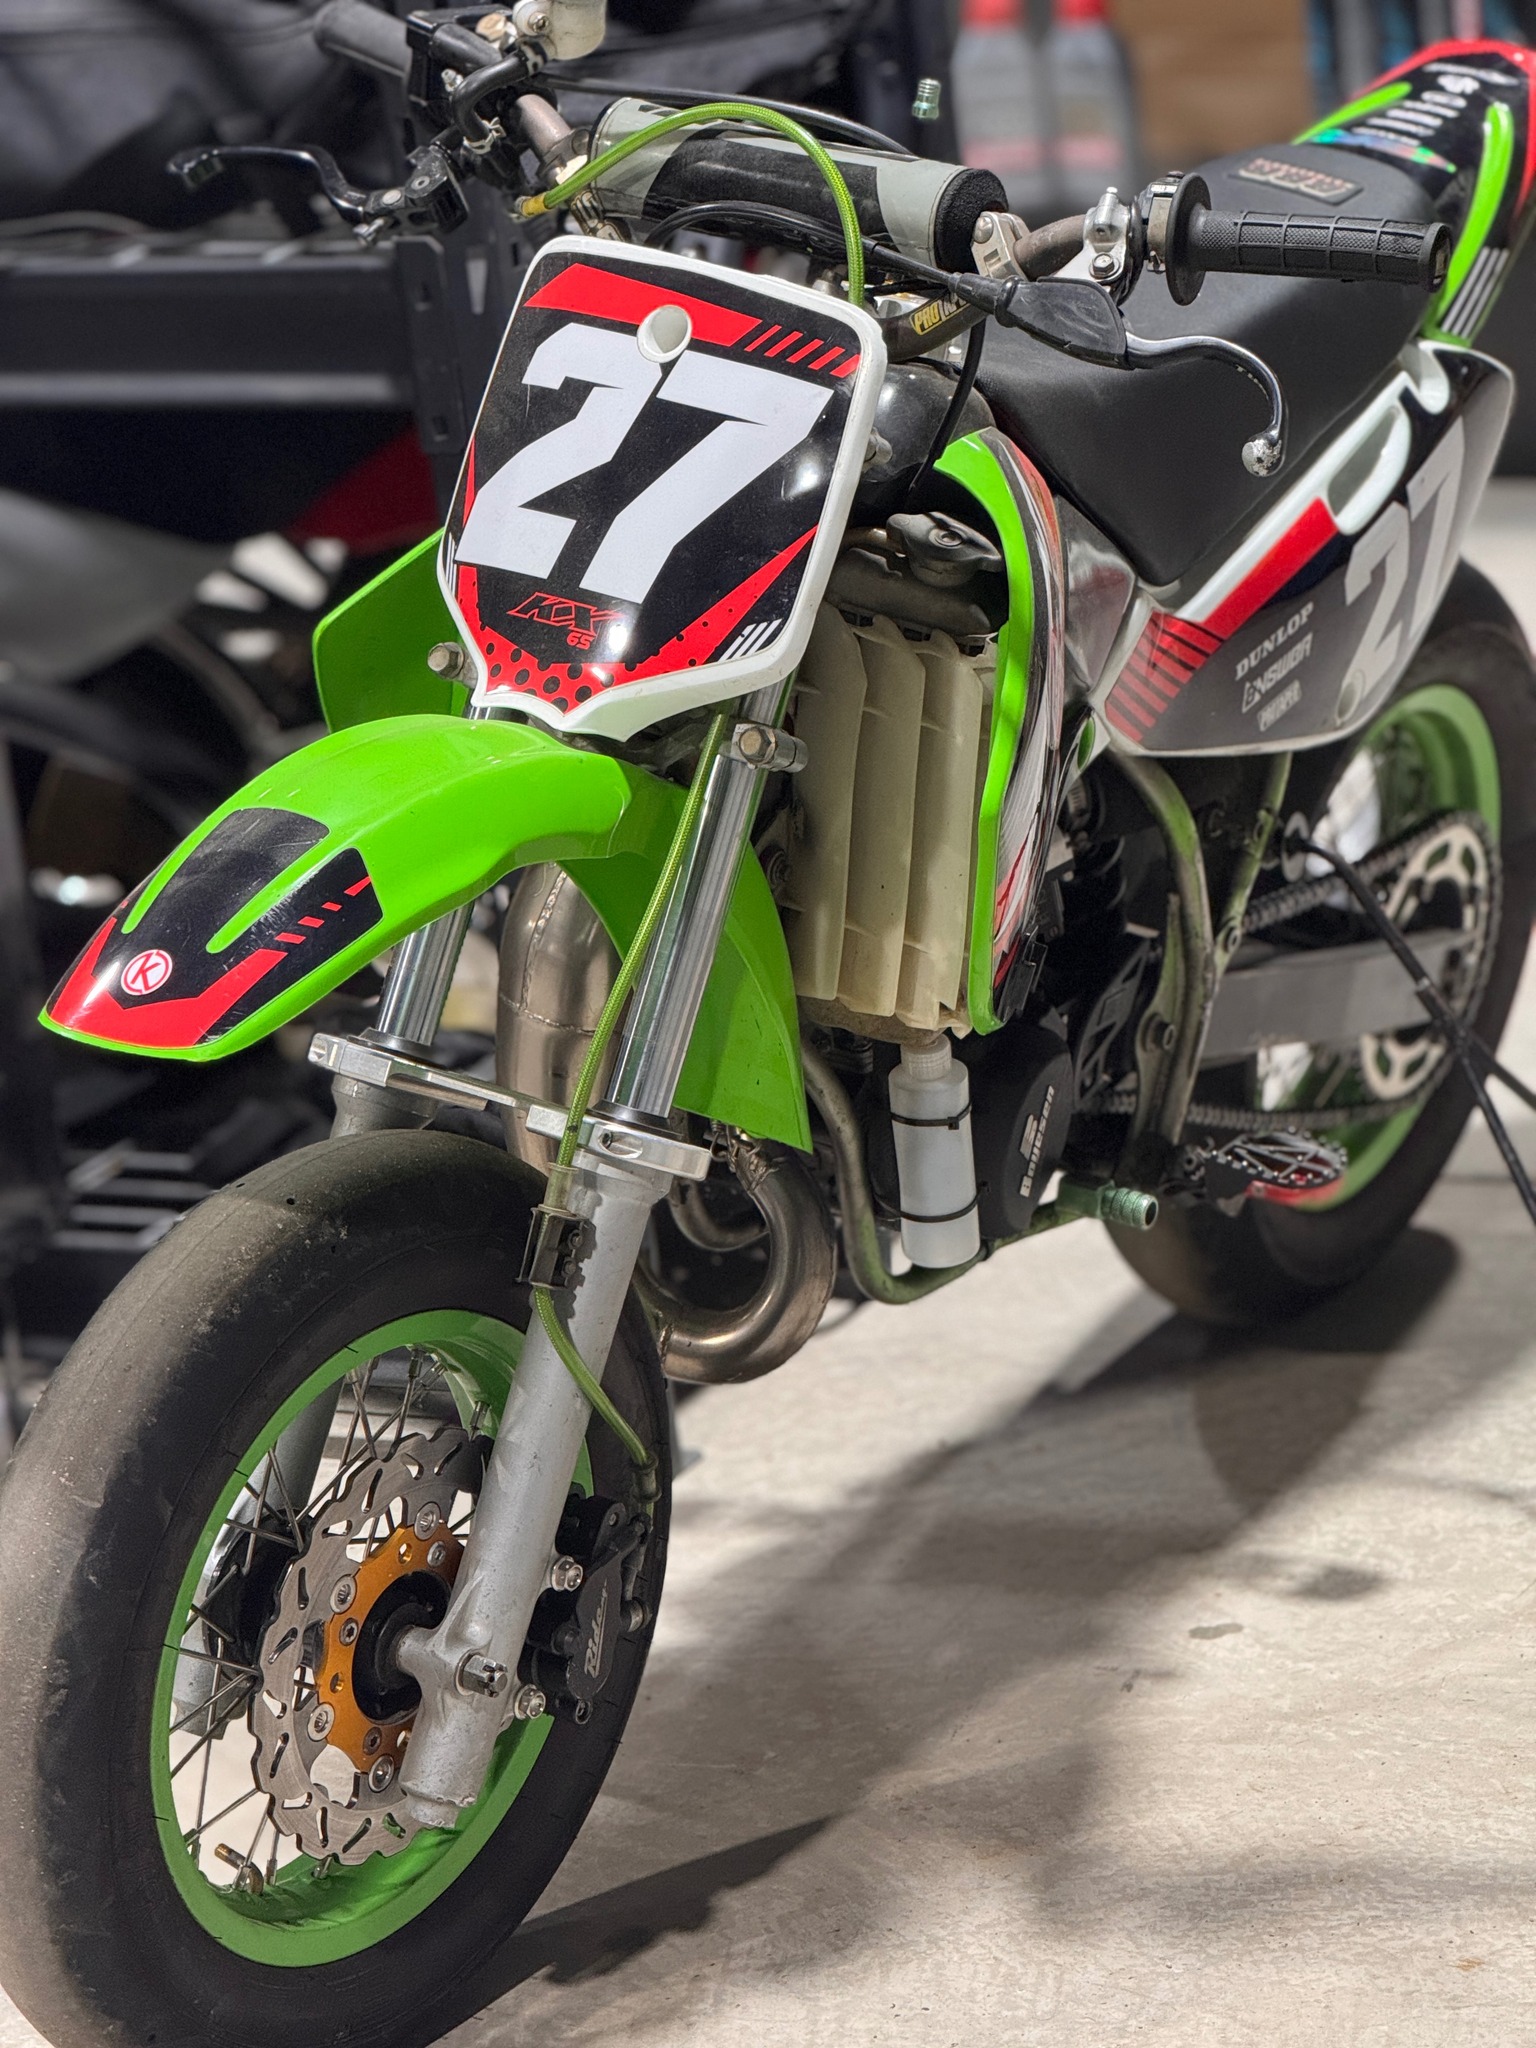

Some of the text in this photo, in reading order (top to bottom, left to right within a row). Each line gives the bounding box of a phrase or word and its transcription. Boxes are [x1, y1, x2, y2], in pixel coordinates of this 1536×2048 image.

[454, 322, 834, 605] 27
[507, 591, 626, 637] KX
[1337, 415, 1465, 718] 27
[1235, 601, 1314, 681] DUNLOP
[1020, 1085, 1055, 1198] Boyesen
